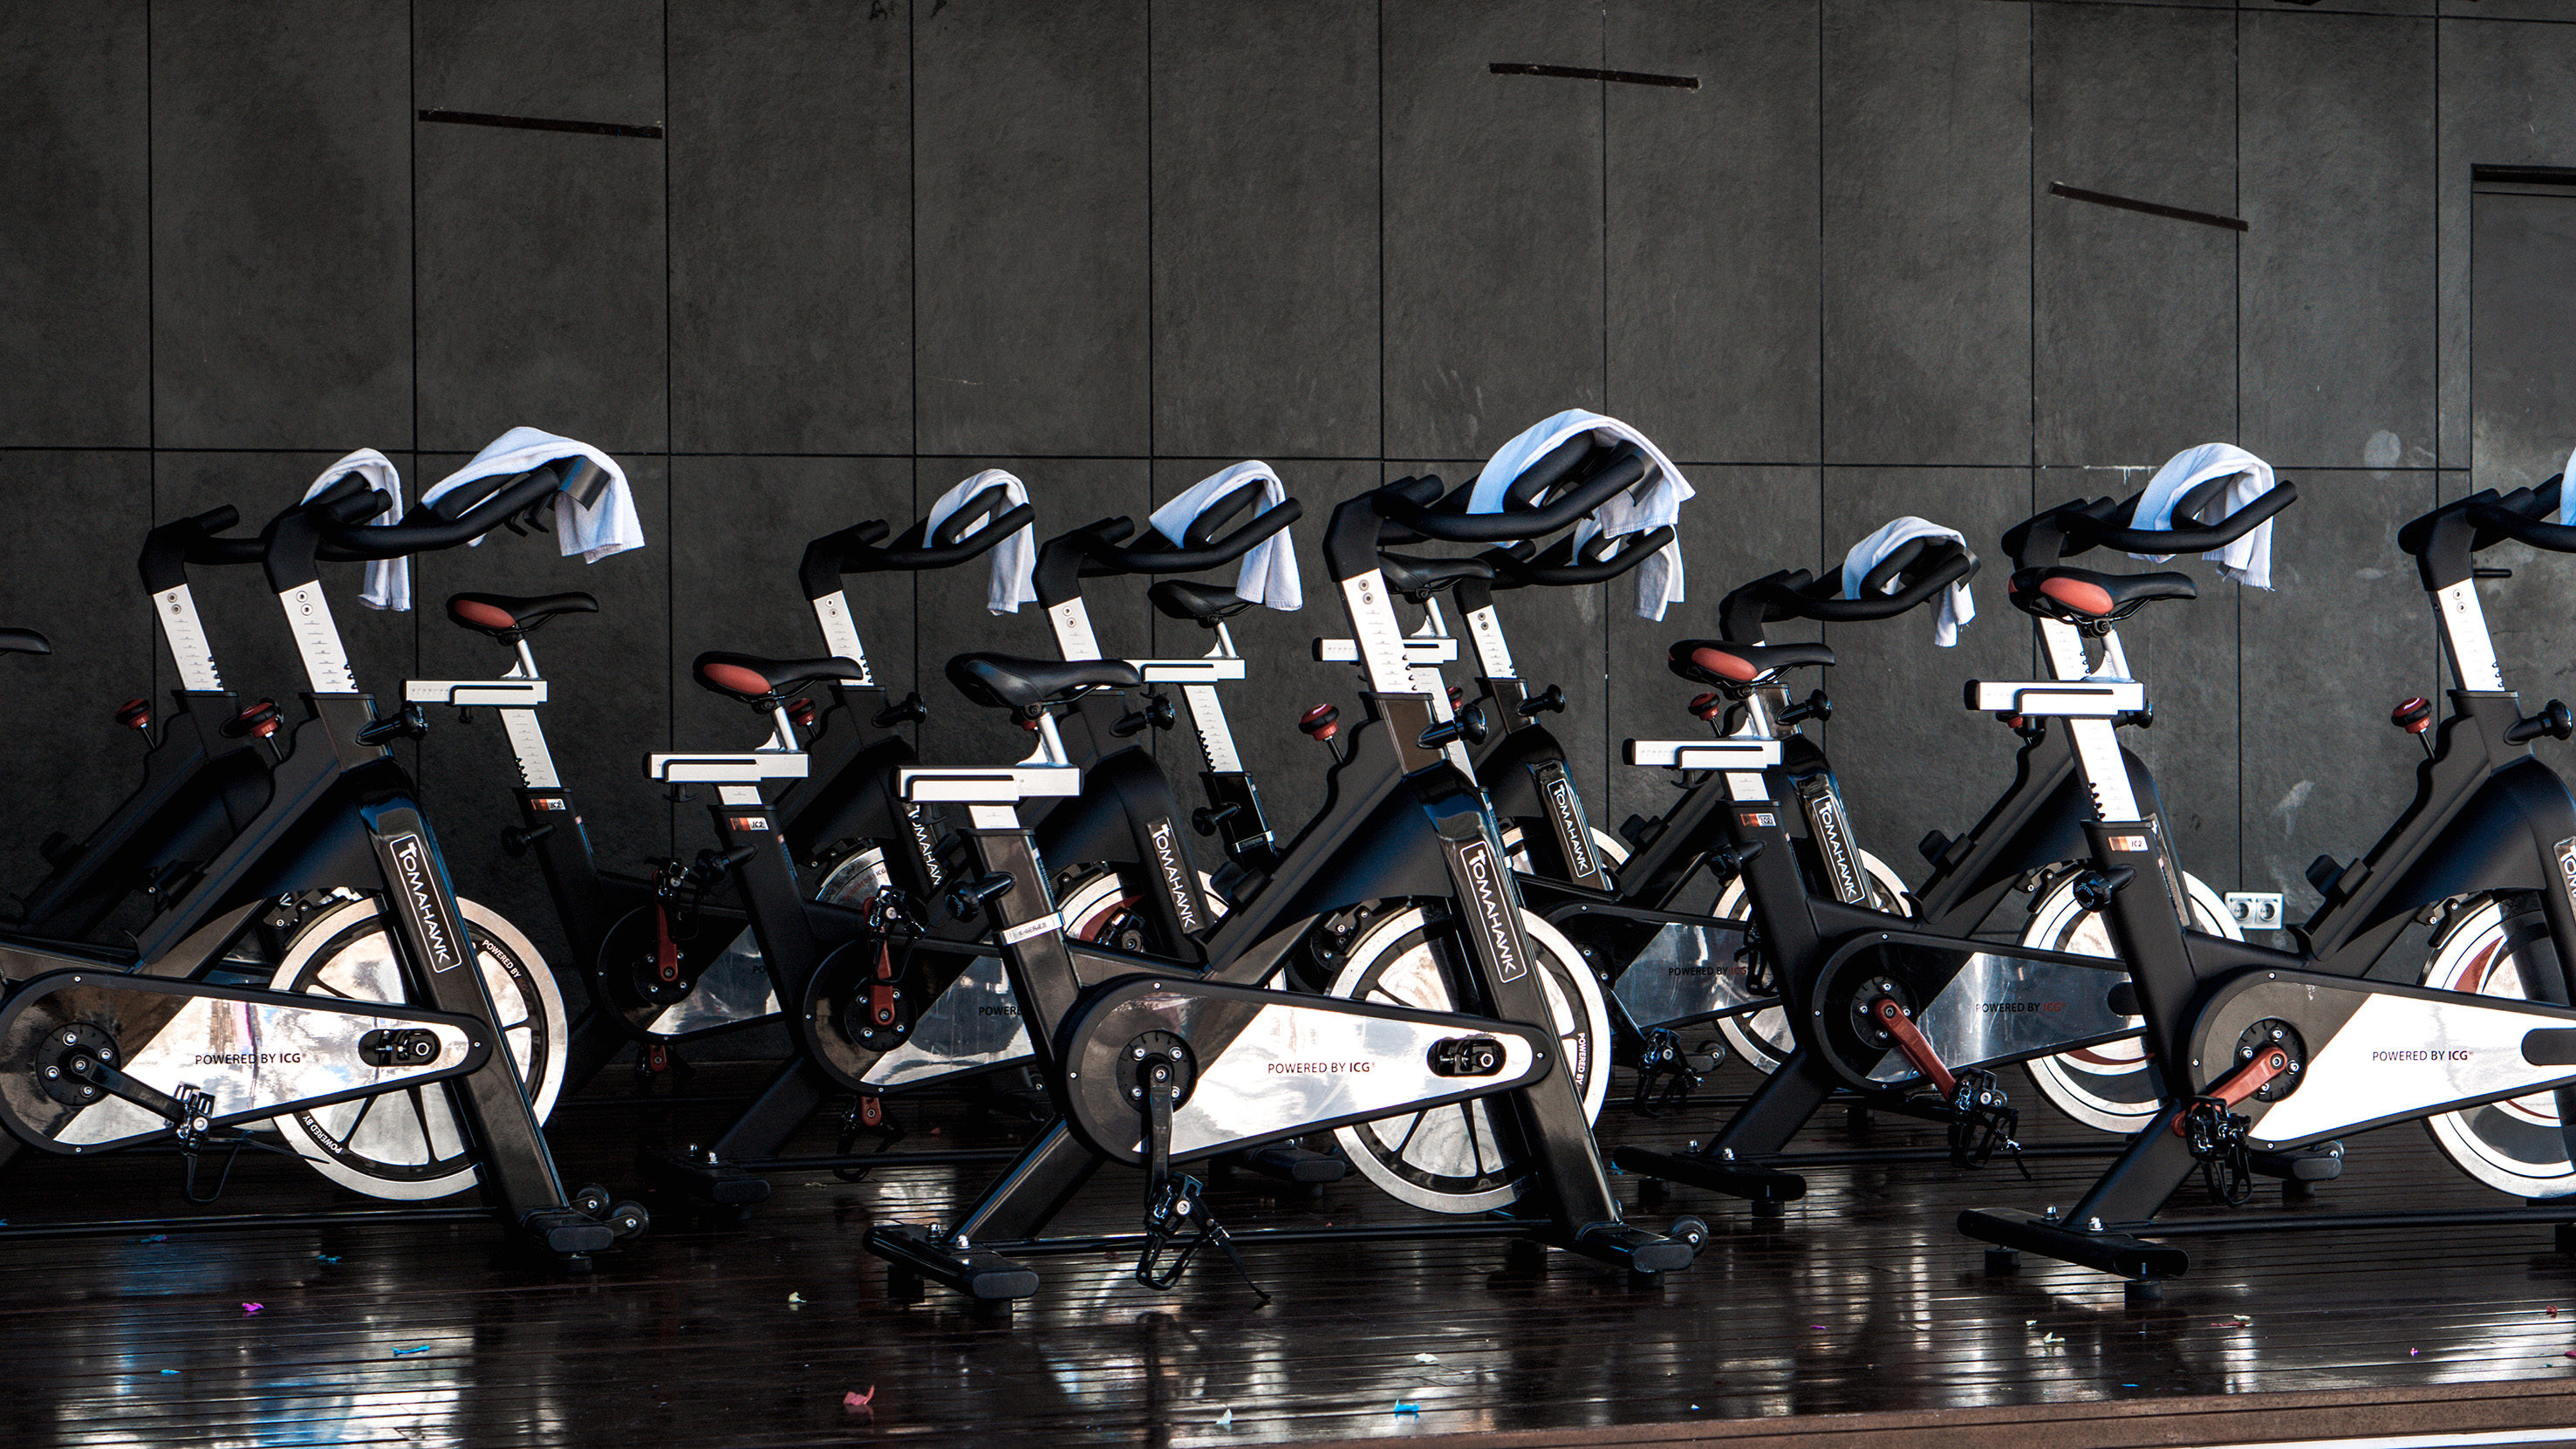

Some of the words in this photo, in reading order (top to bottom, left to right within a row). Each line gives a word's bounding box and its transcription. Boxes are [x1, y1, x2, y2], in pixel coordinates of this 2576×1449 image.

[1554, 783, 1589, 871] TOMAHAWK
[1819, 801, 1857, 898] TOMAHAWK
[1152, 824, 1196, 928] TOMAHAWK
[399, 842, 451, 964] TOMAHAWK
[1468, 849, 1517, 974] TOMAHAWK
[482, 939, 514, 969] POWERED
[510, 967, 522, 978] BY
[1668, 967, 1714, 976] POWERED
[1716, 967, 1729, 975] BY
[1731, 967, 1747, 975] ICG
[1975, 1002, 2026, 1013] POWERED
[2027, 1002, 2040, 1012] BY
[195, 1054, 257, 1065] POWERED
[260, 1053, 277, 1063] BY
[1577, 1032, 1587, 1073] POWERED
[2372, 1050, 2428, 1062] POWERED
[2430, 1049, 2445, 1061] BY
[1268, 1063, 1328, 1074] POWERED
[1330, 1062, 1346, 1073] BY
[1575, 1073, 1584, 1085] BY
[302, 1115, 314, 1126] BY
[310, 1124, 343, 1154] POWERED
